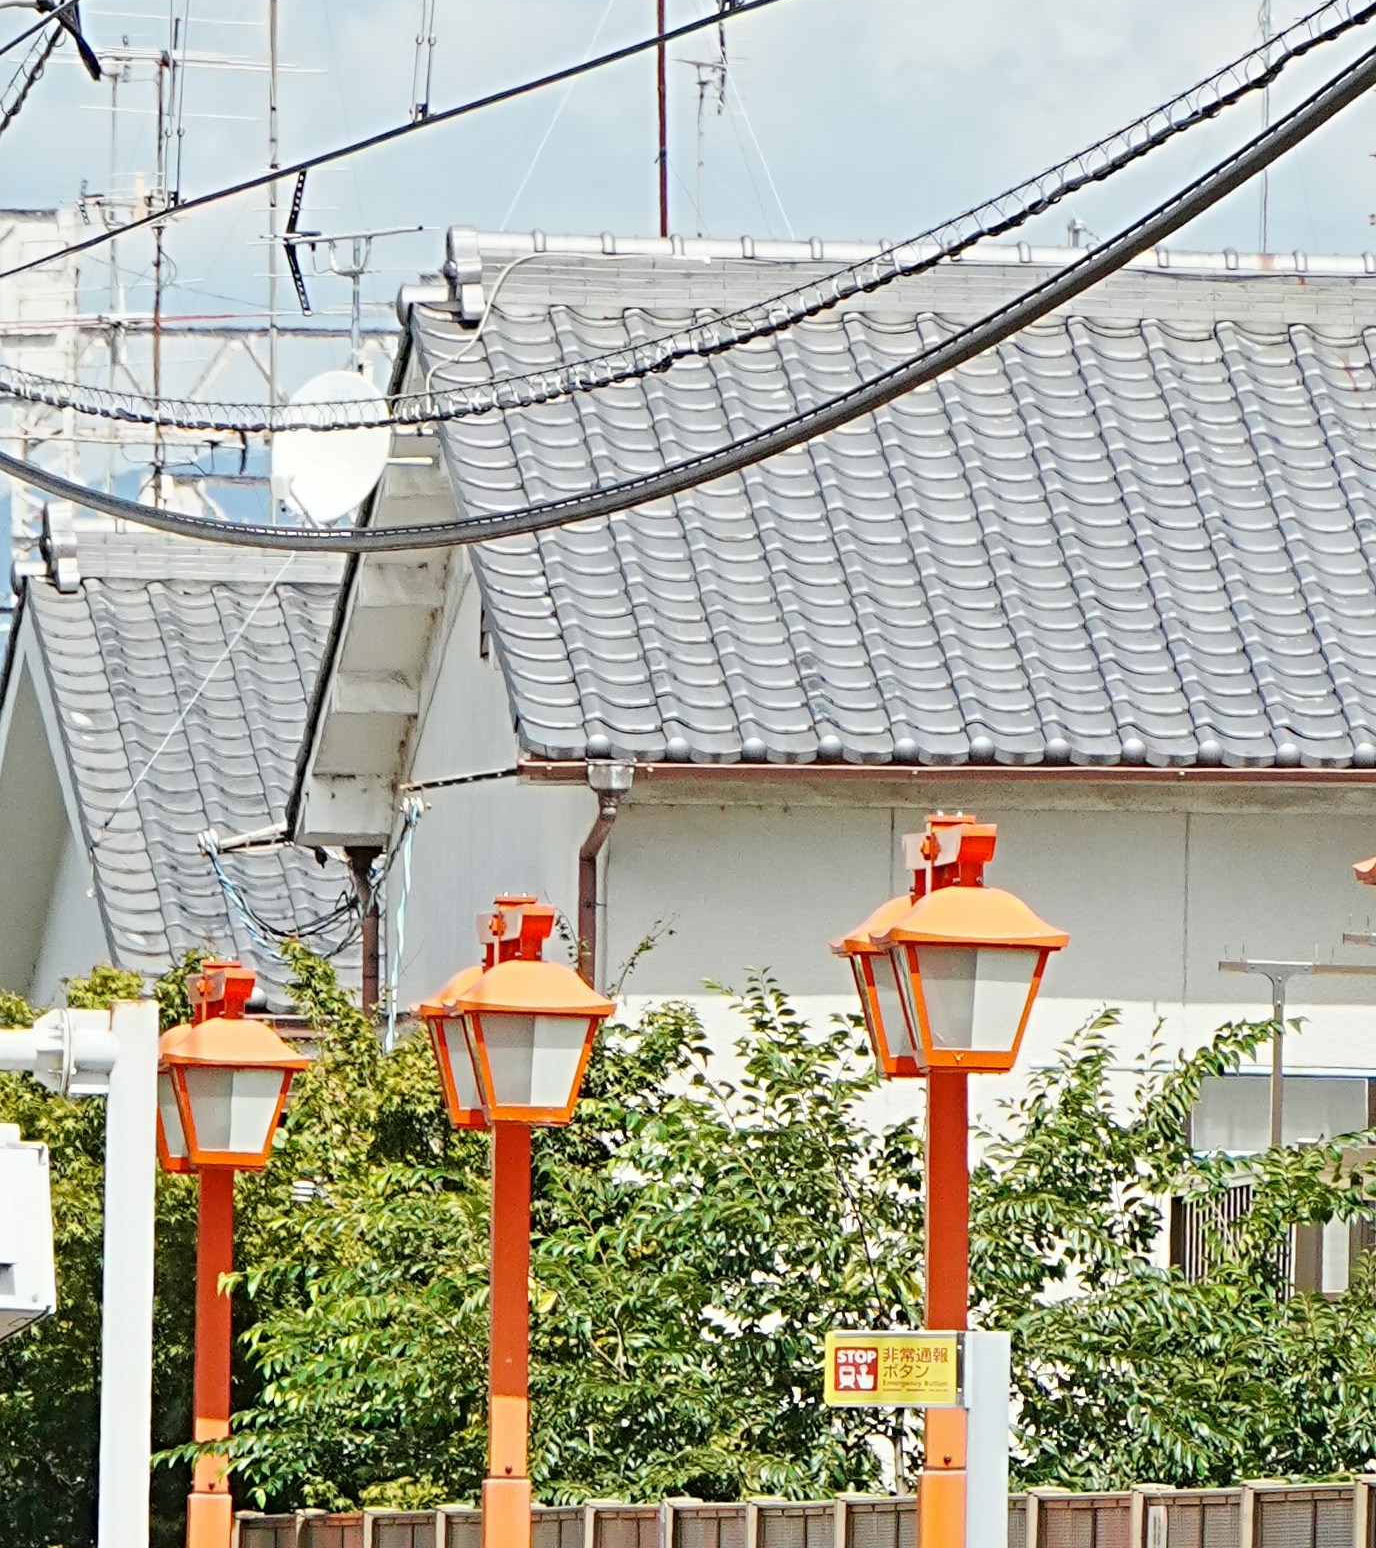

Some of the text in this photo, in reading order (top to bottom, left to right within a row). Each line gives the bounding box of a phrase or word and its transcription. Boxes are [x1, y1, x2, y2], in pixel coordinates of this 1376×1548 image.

[836, 1349, 878, 1364] STOP
[882, 1346, 949, 1364] 非常通報
[883, 1364, 930, 1379] ボタン
